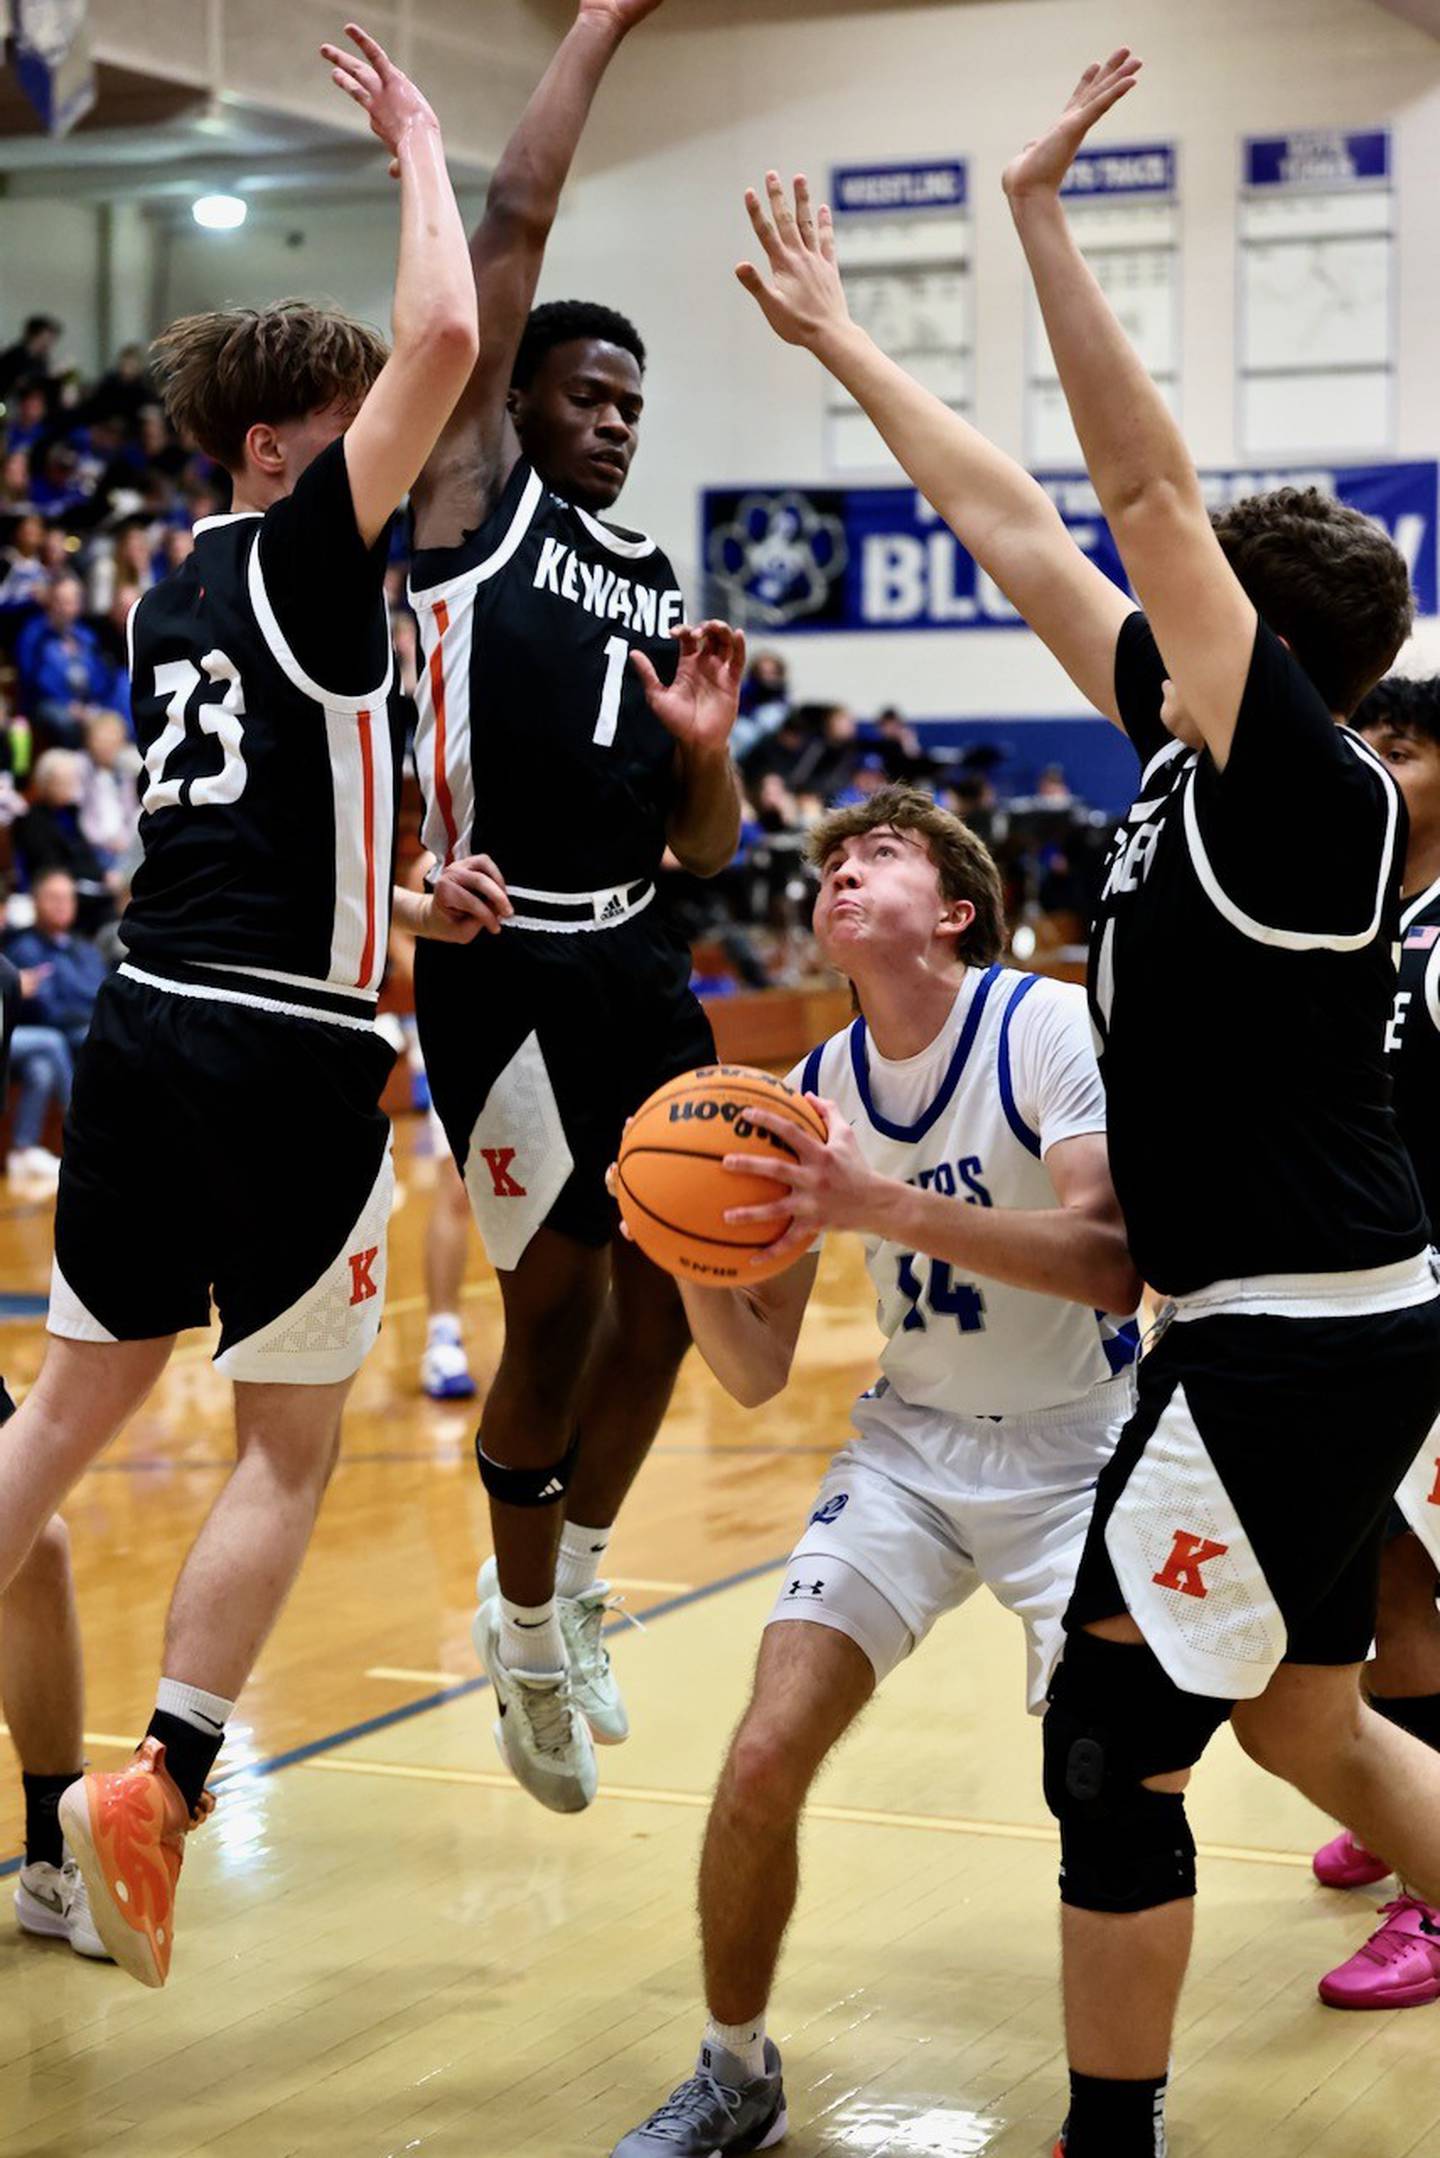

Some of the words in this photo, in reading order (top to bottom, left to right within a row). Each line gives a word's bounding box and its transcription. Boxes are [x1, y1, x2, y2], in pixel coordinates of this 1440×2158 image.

[532, 537, 688, 640] KEWANE
[141, 648, 249, 815] 23
[592, 635, 629, 747] 1
[479, 1147, 527, 1197] K
[348, 1246, 378, 1306] K
[897, 1252, 987, 1335] 14
[1152, 1529, 1229, 1600] K
